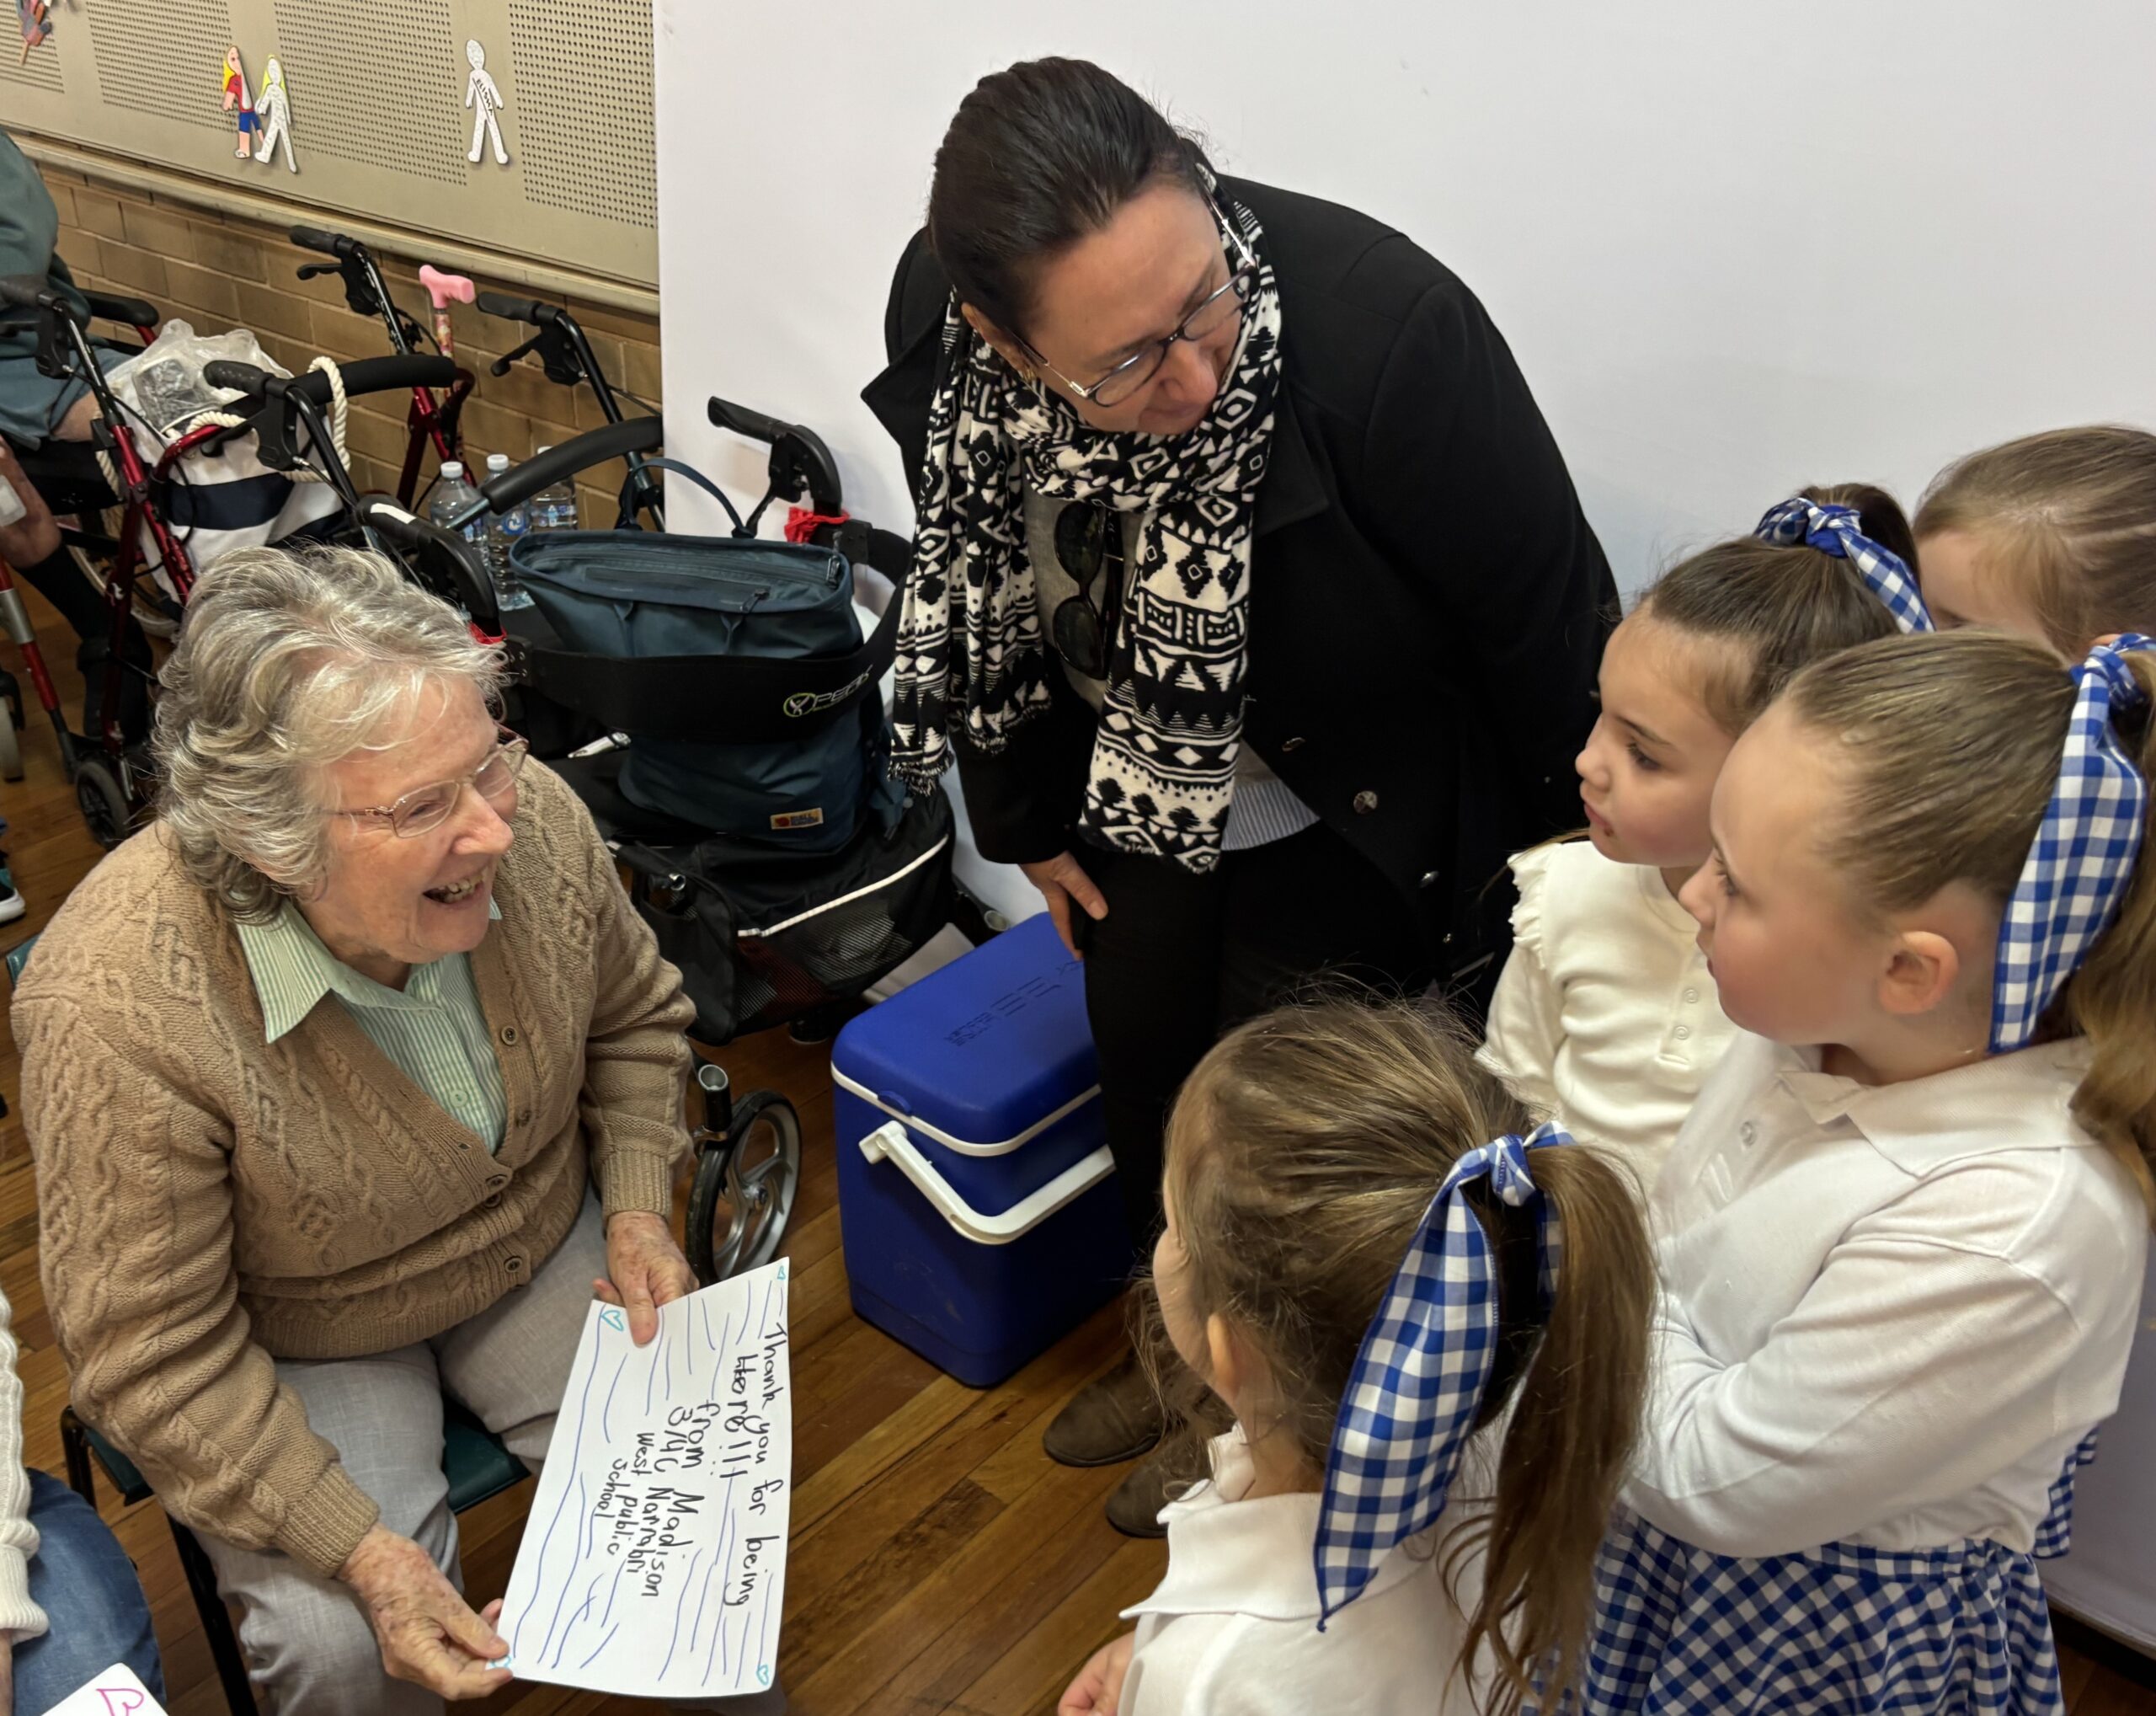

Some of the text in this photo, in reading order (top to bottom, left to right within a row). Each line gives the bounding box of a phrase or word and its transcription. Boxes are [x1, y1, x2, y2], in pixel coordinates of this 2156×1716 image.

[606, 1432, 655, 1556] West public
[627, 1406, 693, 1574] 3/4C Narrabri
[641, 1399, 721, 1597] from Madison
[723, 1321, 787, 1606] Thank you for being
